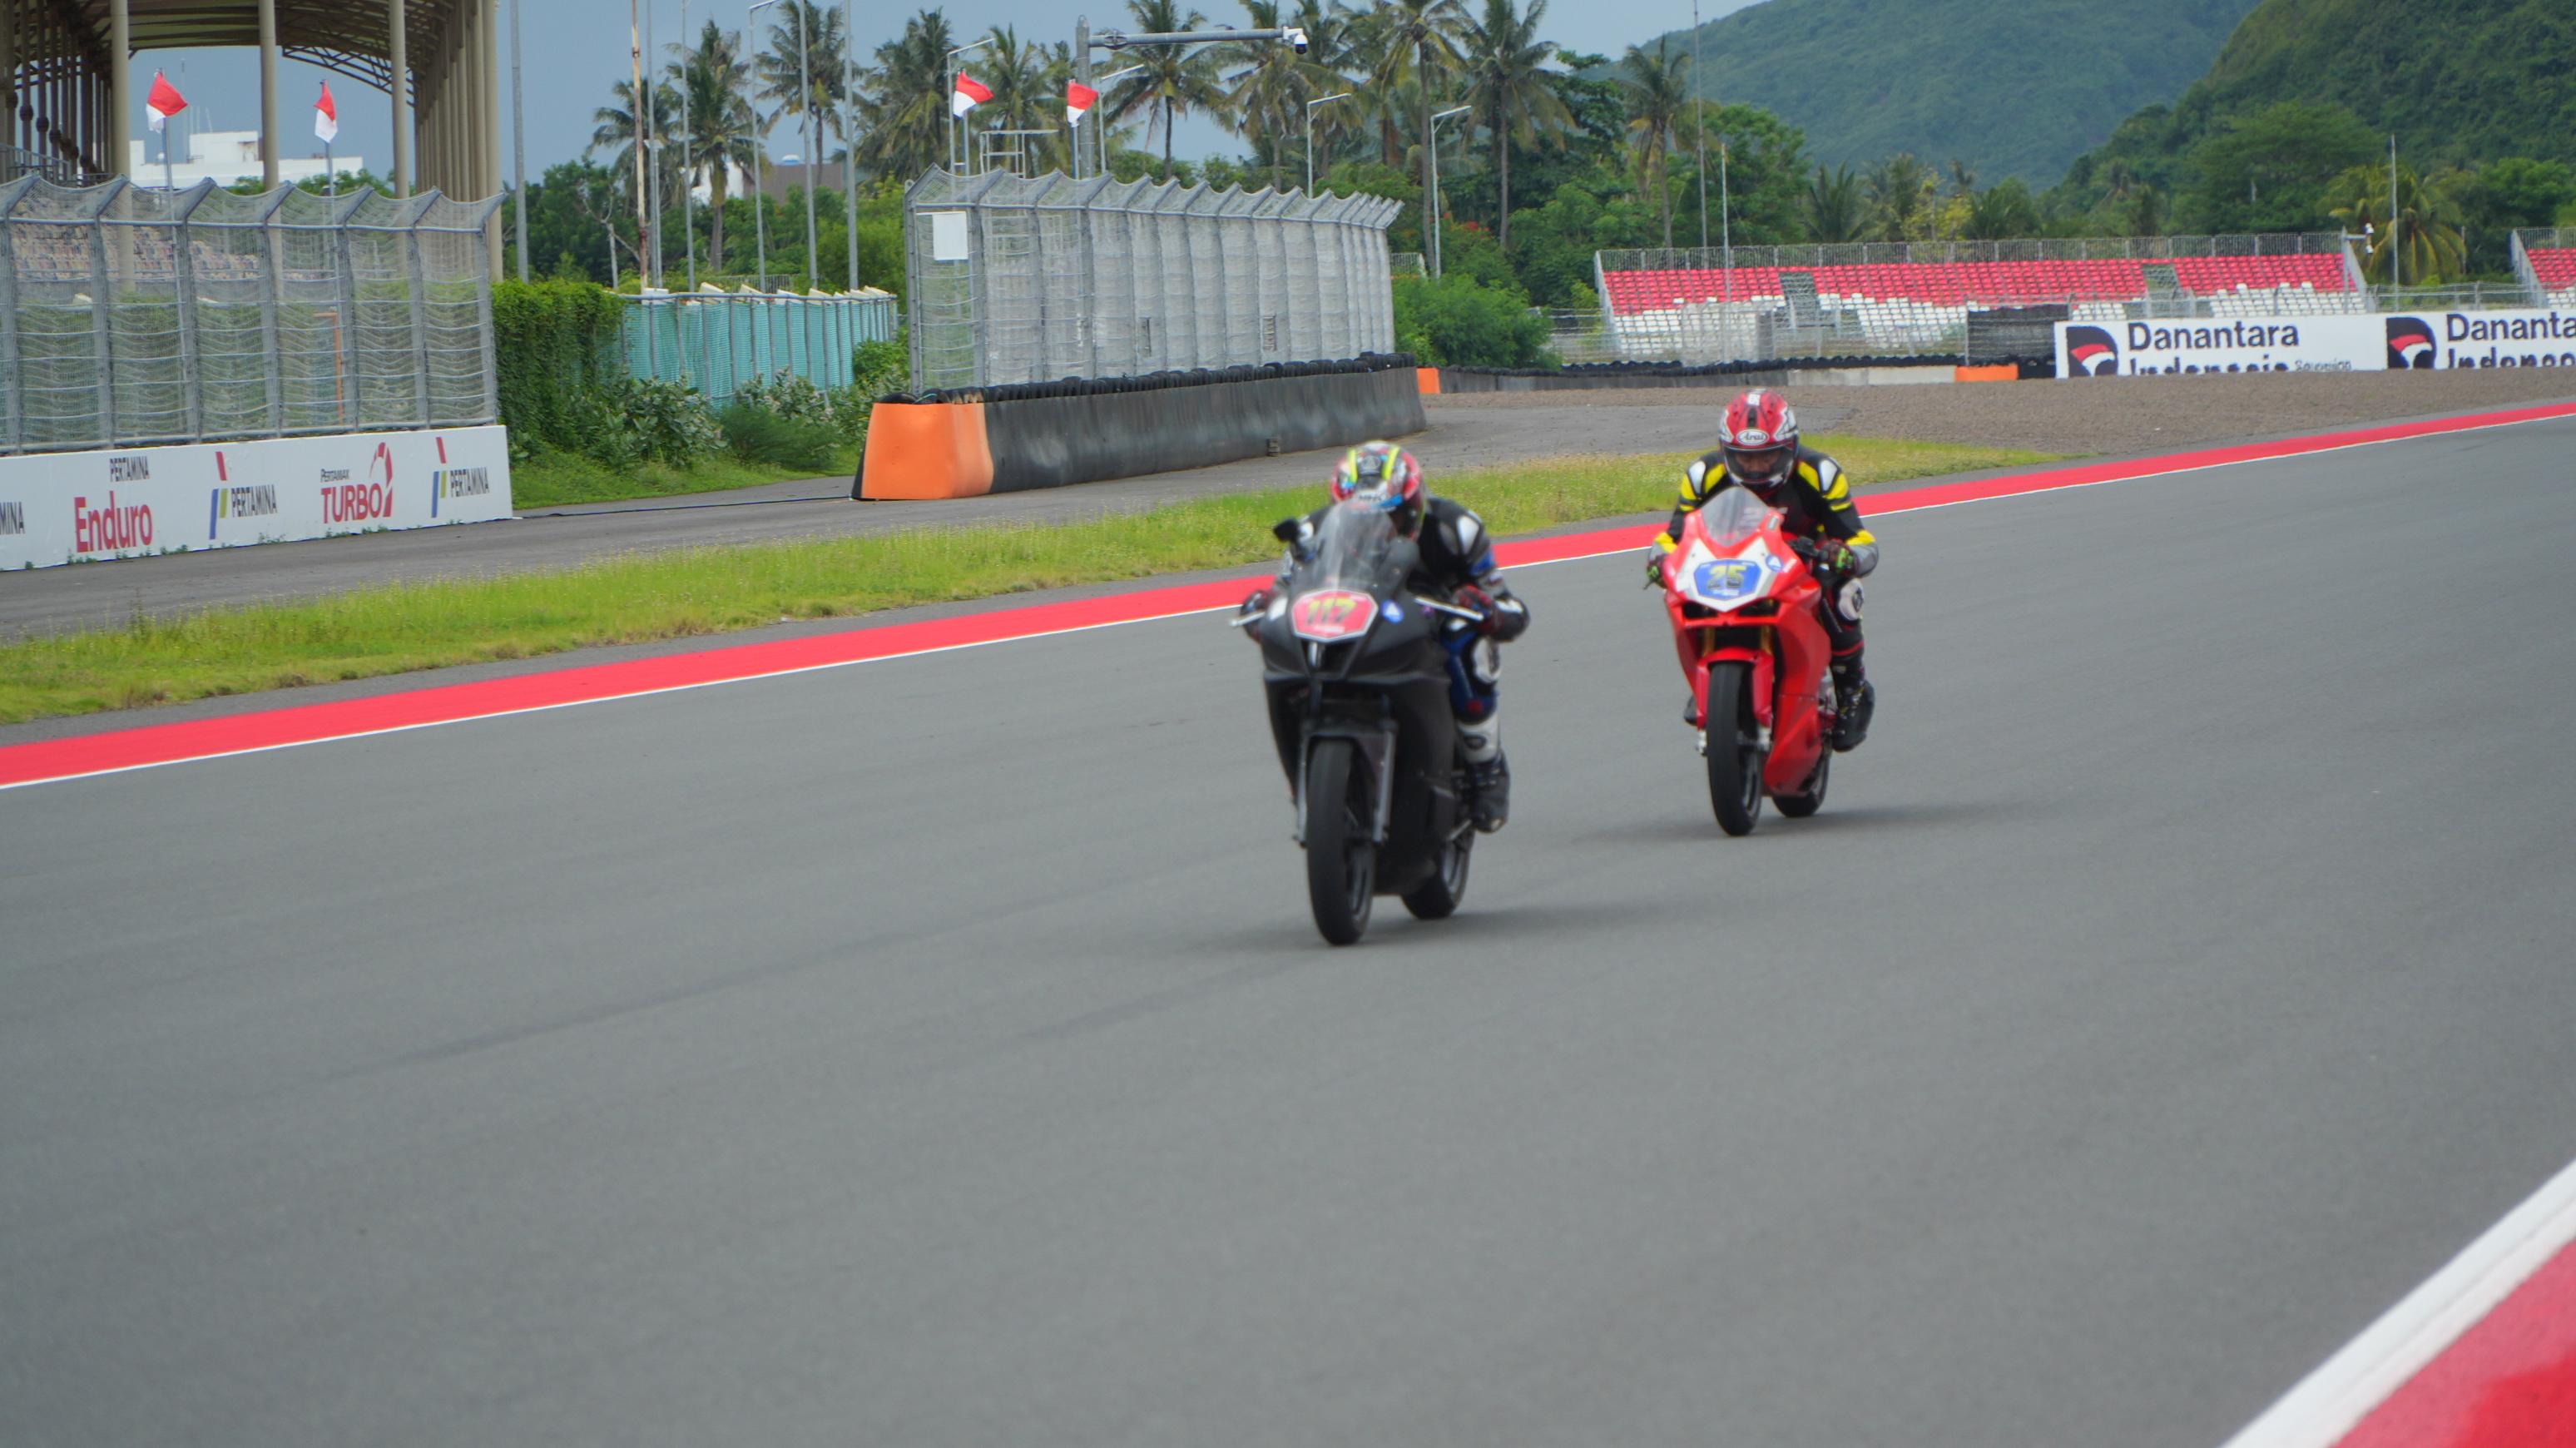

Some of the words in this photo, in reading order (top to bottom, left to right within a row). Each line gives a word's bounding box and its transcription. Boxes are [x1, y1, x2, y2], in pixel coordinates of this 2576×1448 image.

[2128, 320, 2299, 350] Danantara
[2446, 311, 2576, 341] Dananta
[110, 456, 150, 482] PERTAMINA
[320, 468, 350, 483] PERTAMAX
[450, 467, 490, 498] PERTAMINA
[231, 484, 277, 518] PERTAMINA
[320, 483, 383, 524] TURBO
[74, 490, 152, 553] Enduro
[1708, 565, 1746, 589] 25
[1306, 598, 1356, 622] 117
